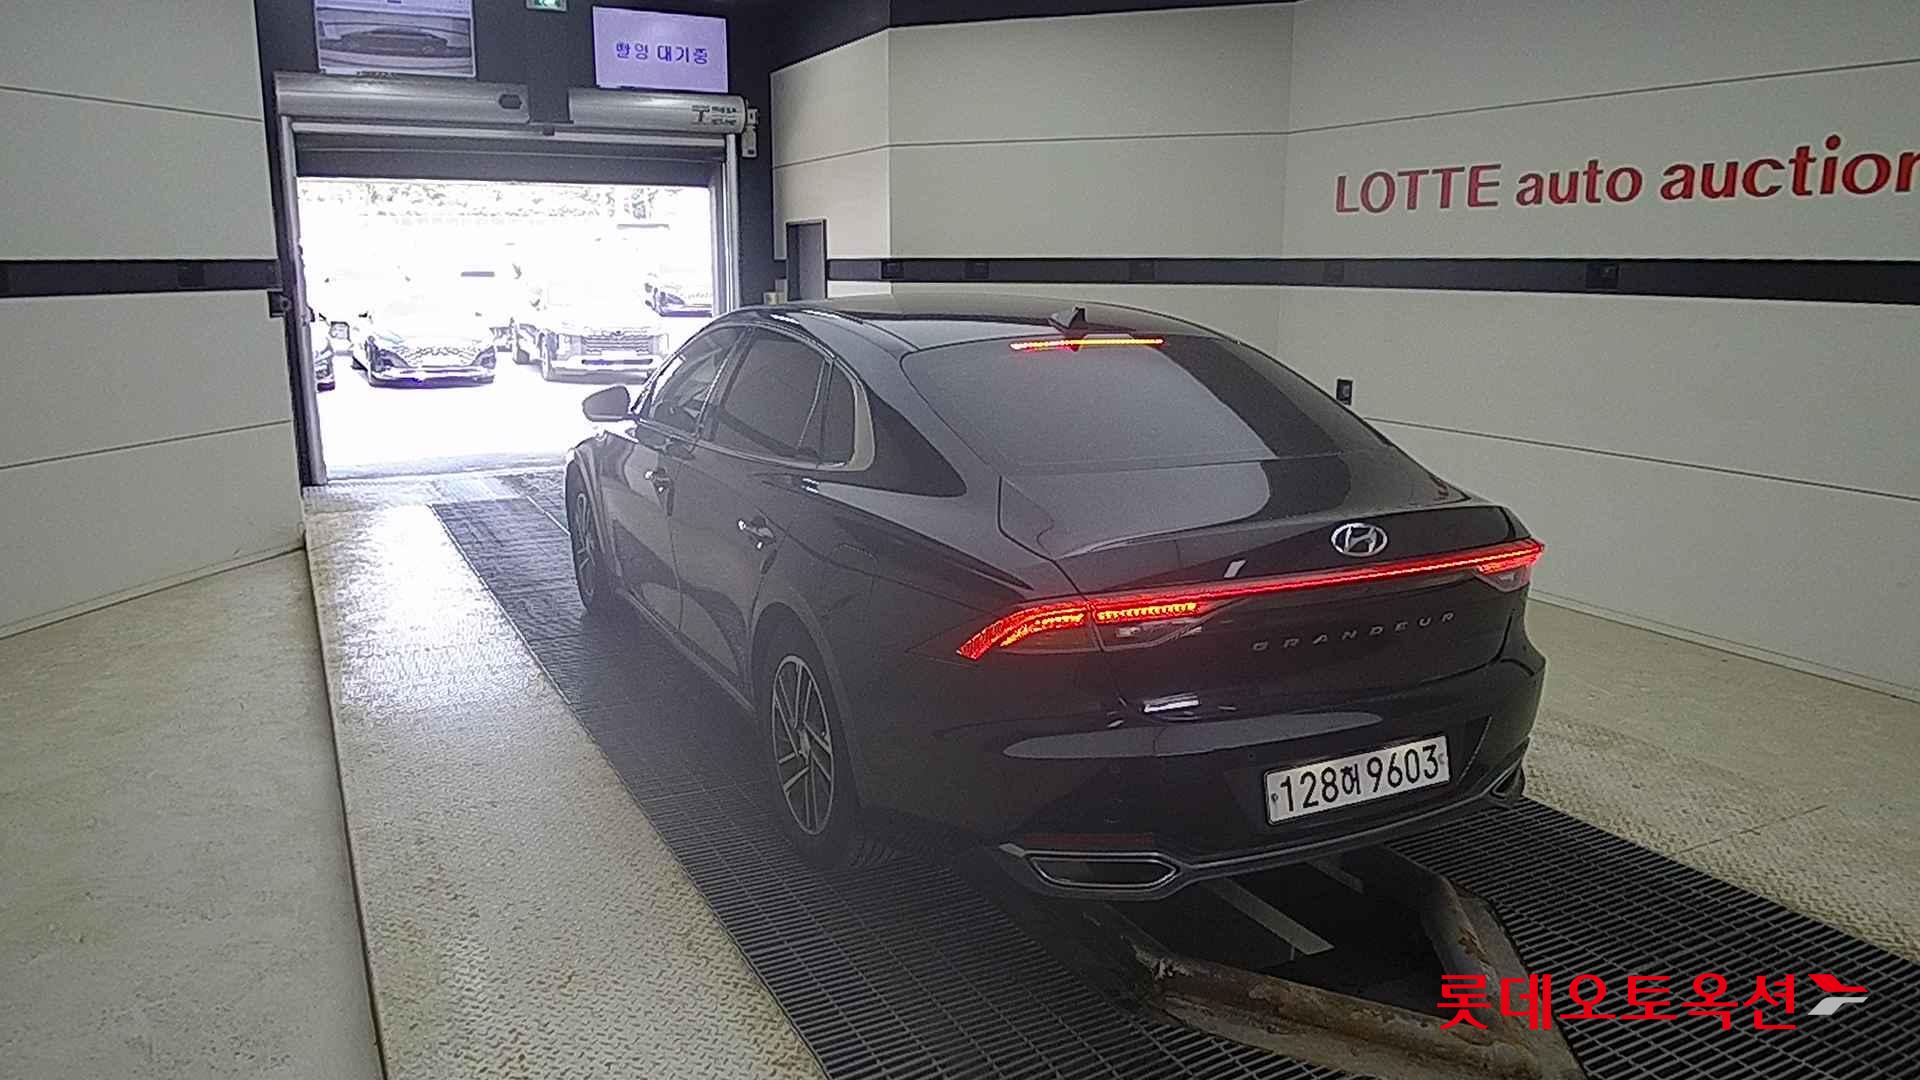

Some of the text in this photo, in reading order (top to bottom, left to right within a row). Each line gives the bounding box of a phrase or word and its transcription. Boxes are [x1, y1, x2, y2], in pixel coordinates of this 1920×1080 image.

[656, 45, 708, 65] 대기중
[1335, 163, 1501, 213] LOTTE
[1515, 159, 1643, 206] auto
[1252, 611, 1455, 652] GRANDEUR
